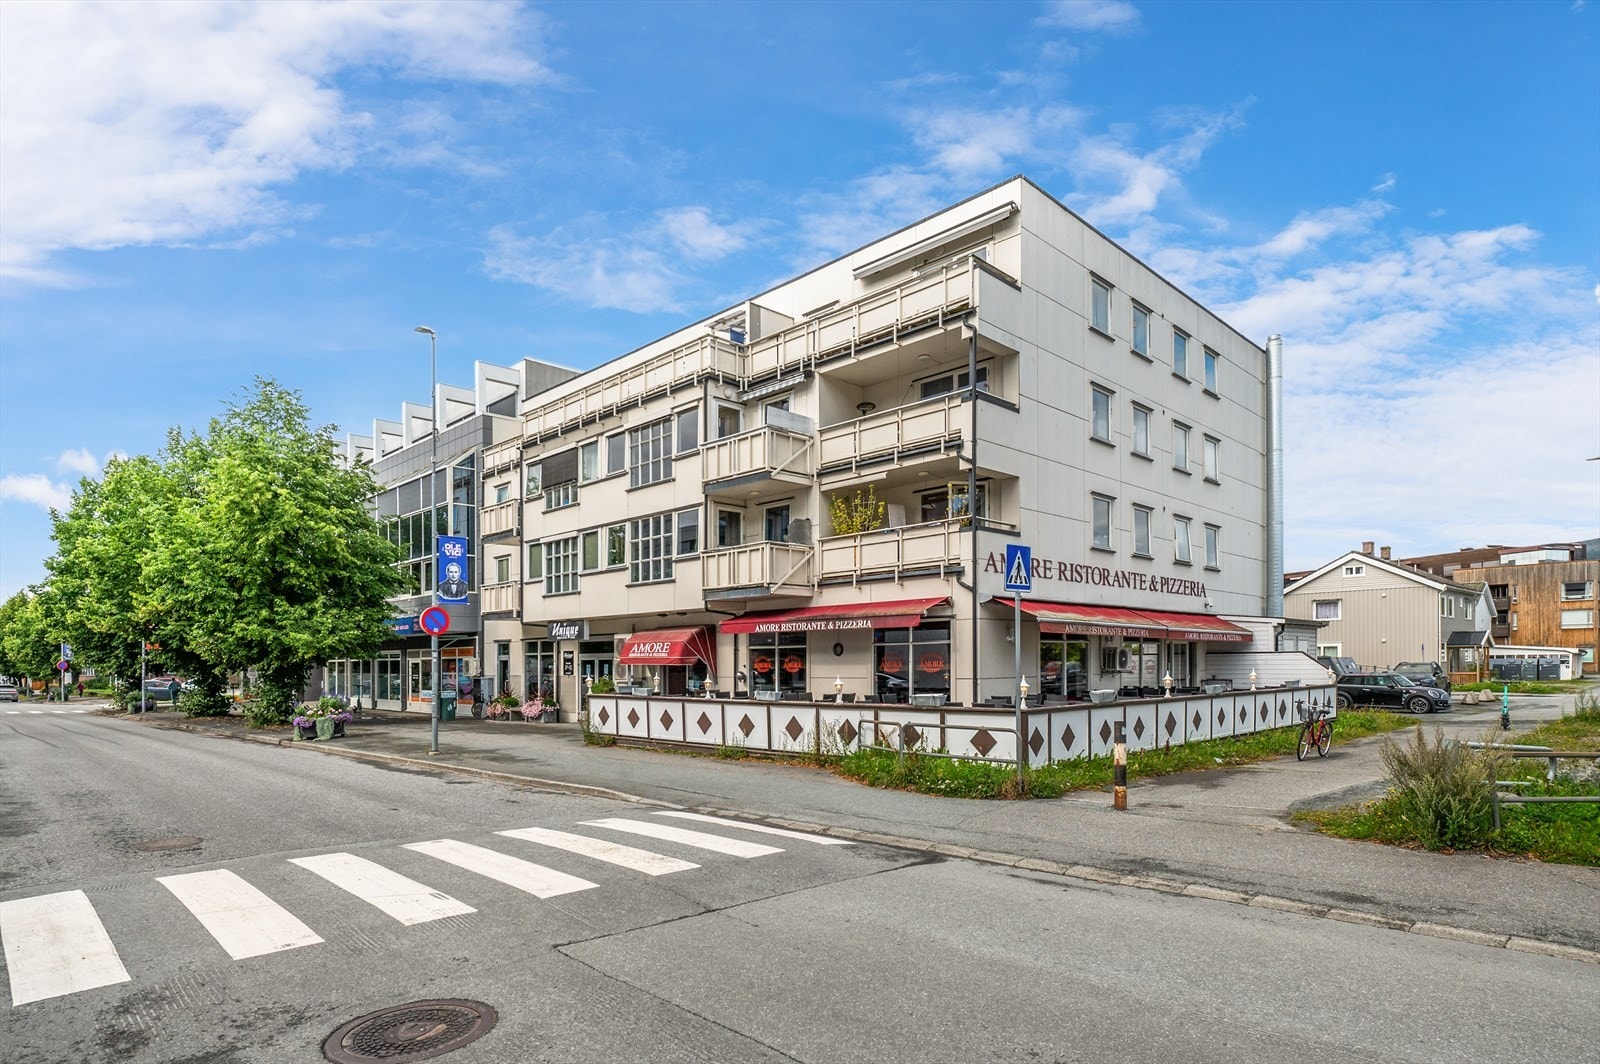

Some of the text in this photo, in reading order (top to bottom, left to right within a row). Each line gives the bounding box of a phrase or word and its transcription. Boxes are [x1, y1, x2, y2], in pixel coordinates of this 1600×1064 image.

[1057, 561, 1147, 591] RISTORANTE
[1149, 575, 1159, 592] &
[1160, 576, 1207, 598] PIZZERIA
[551, 622, 579, 639] Unique
[754, 619, 872, 633] AMORE RISTORANTE & PIZZERIA
[1065, 624, 1087, 634] AMORE
[1088, 626, 1123, 636] RISTORANTE
[1127, 628, 1149, 637] PIZZERIA
[1184, 632, 1200, 640] AMORE
[630, 642, 671, 653] AMORE
[920, 660, 944, 668] AMORE
